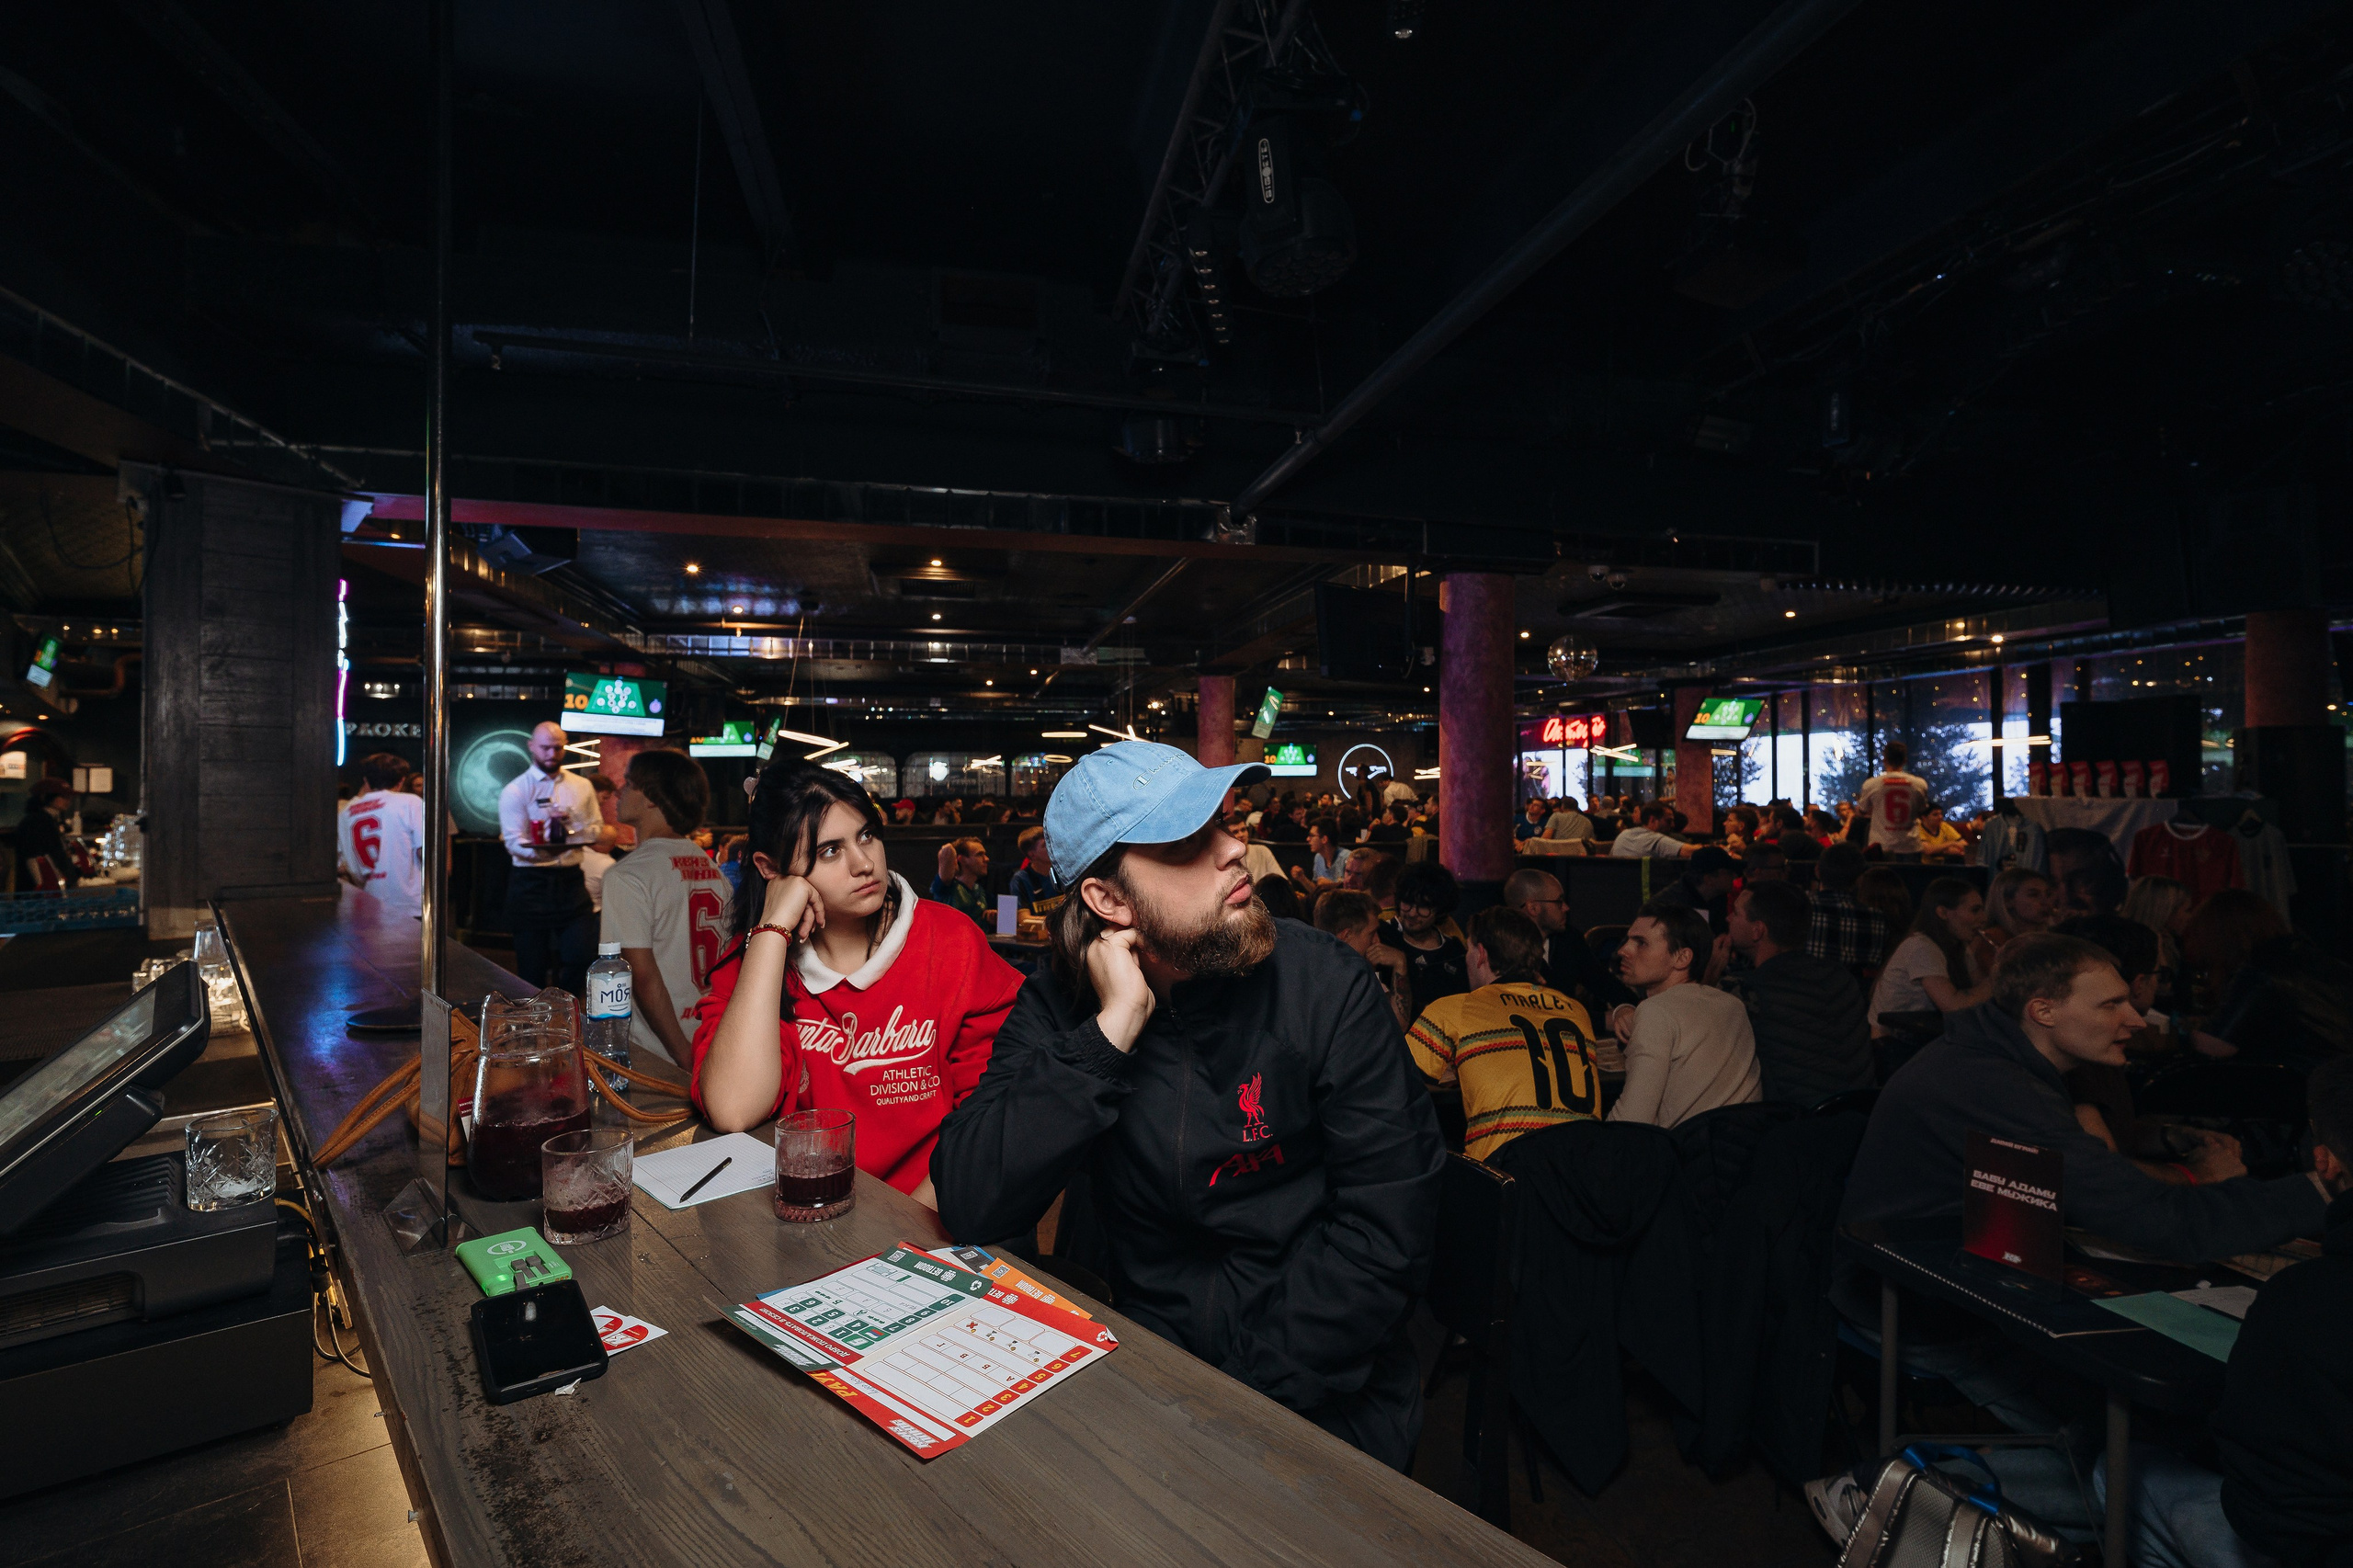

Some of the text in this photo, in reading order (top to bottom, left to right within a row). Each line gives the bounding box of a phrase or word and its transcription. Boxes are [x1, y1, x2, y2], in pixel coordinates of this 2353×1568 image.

[564, 694, 589, 710] 10
[1884, 790, 1909, 824] 6
[351, 815, 381, 869] 6
[688, 889, 723, 994] 6
[831, 1005, 936, 1065] Barbara
[882, 1065, 932, 1082] ATHLETIC
[1509, 1014, 1596, 1115] 10
[870, 1080, 918, 1096] DIVISION
[920, 1078, 927, 1091] &
[919, 1090, 938, 1101] CRAFT
[1972, 1169, 2058, 1200] БАБУ АДАМУ
[1970, 1178, 2059, 1212] ЕВЕ МУЖИКА
[914, 1261, 944, 1277] BETBOOM
[1015, 1279, 1044, 1300] BETBOOM
[1034, 1372, 1046, 1381] 5
[1000, 1393, 1012, 1402] 3
[982, 1403, 995, 1412] 2
[963, 1415, 976, 1424] 1
